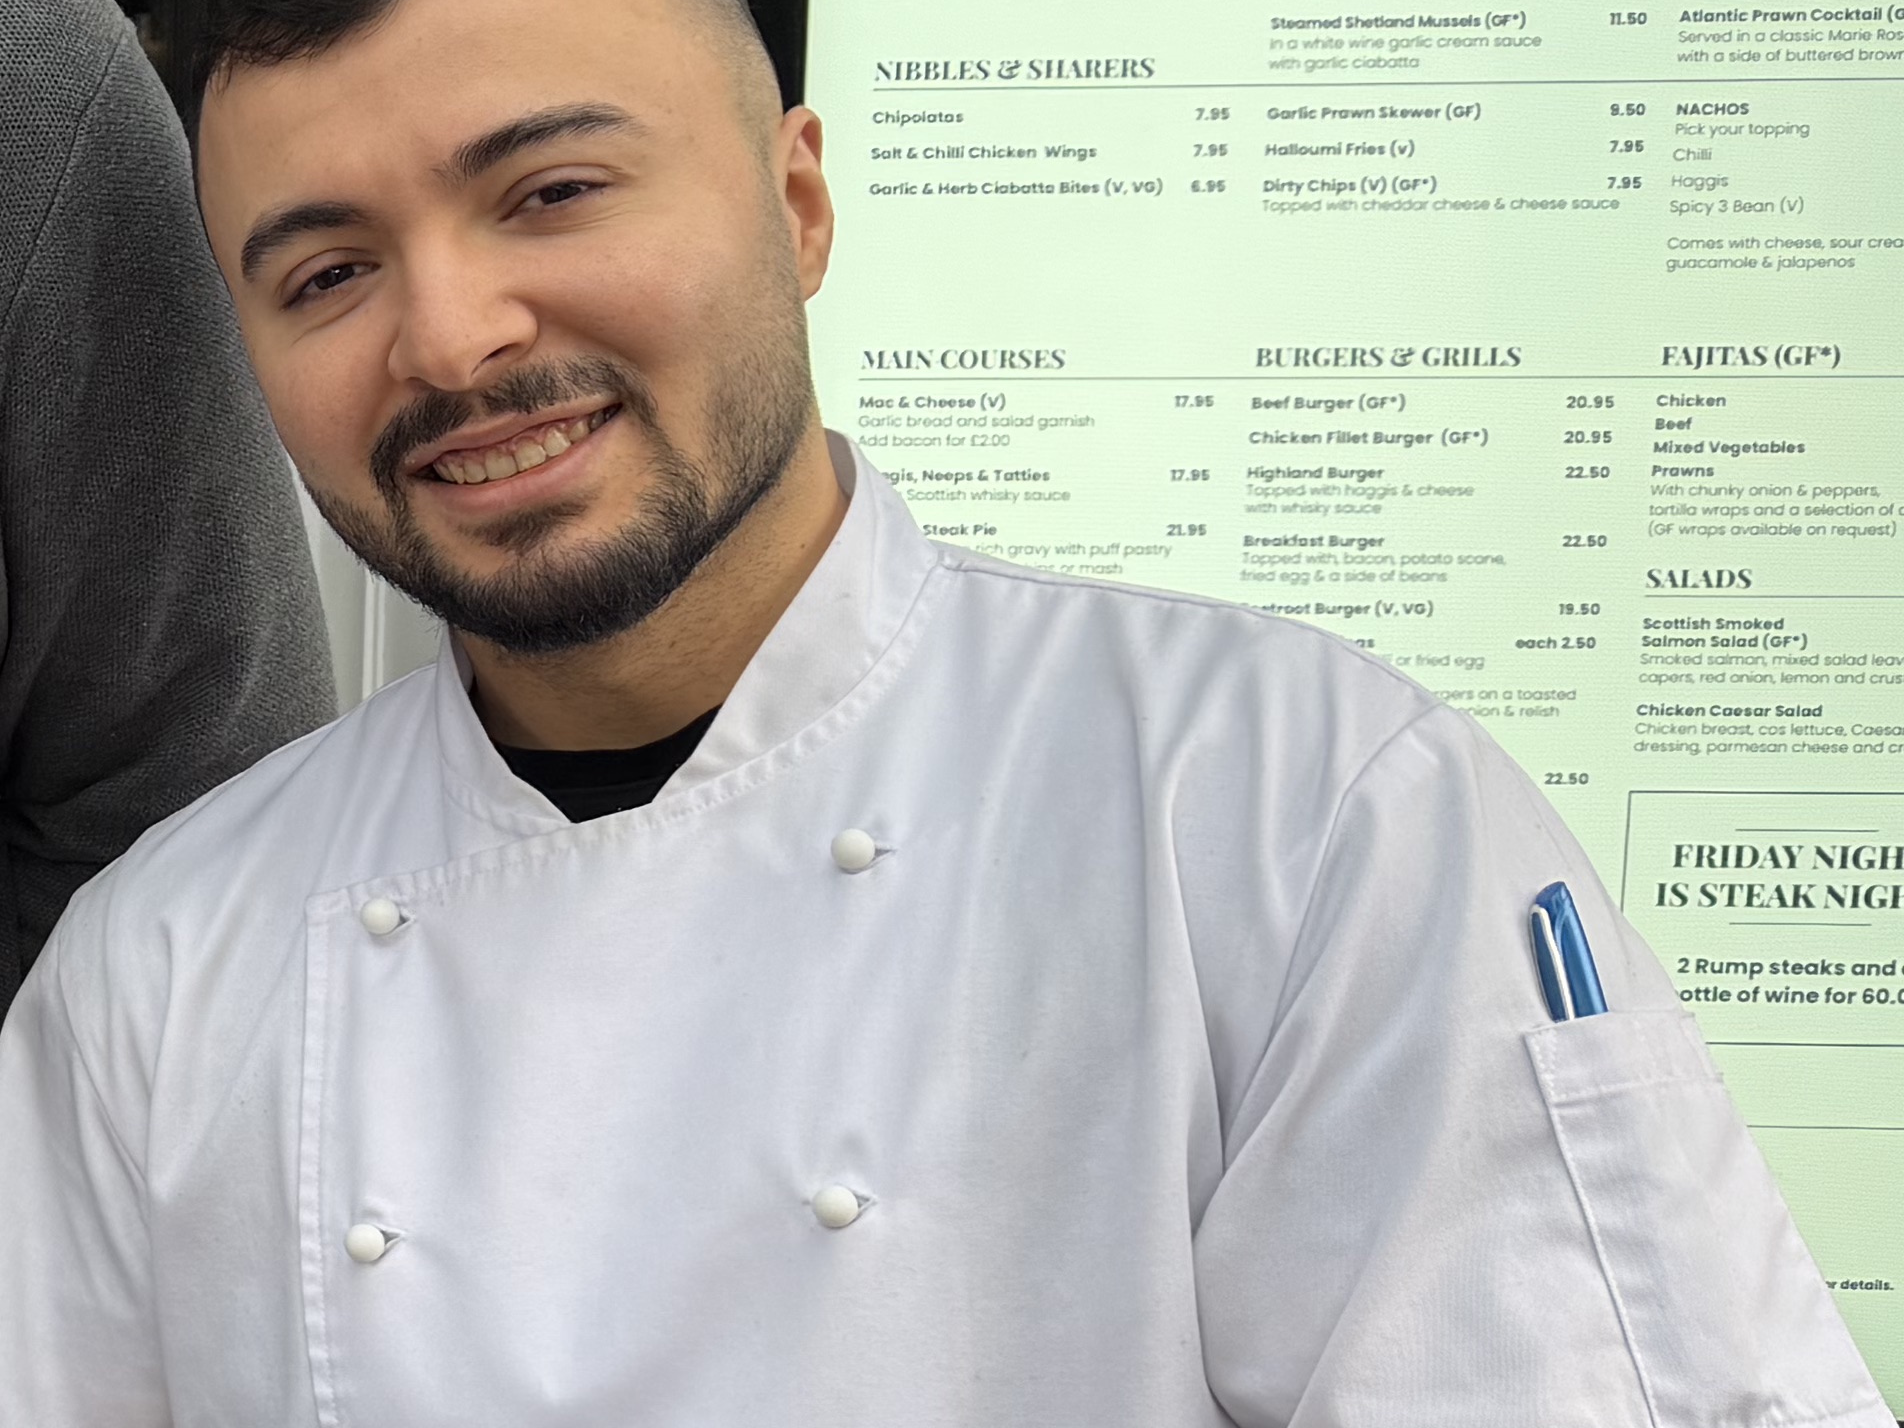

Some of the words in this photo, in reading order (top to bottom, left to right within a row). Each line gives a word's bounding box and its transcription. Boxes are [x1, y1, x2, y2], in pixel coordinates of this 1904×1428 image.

[876, 60, 990, 81] NIBBLES
[998, 60, 1021, 80] &
[1028, 58, 1154, 80] SHARERS
[1676, 103, 1749, 115] NACHOS
[862, 350, 933, 369] MAIN
[941, 350, 1065, 369] COURSES
[1256, 348, 1383, 367] BURGERS
[1390, 347, 1415, 367] &
[1422, 347, 1521, 367] GRILLS
[1662, 346, 1767, 370] FAJITAS
[1656, 394, 1726, 407] Chicken
[1655, 417, 1692, 430] Beef
[1653, 440, 1704, 453] Mixed
[1709, 441, 1805, 457] Vegetables
[1652, 465, 1714, 477] Prawns
[1647, 569, 1751, 589] SALADS
[1636, 703, 1705, 716] Chicken
[1710, 705, 1771, 717] Caesar
[1776, 705, 1822, 717] Salad
[1674, 844, 1803, 869] FRIDAY
[1813, 846, 1904, 870] NIGH
[1656, 883, 1688, 907] IS
[1698, 883, 1815, 908] STEAK
[1824, 885, 1904, 909] NIG
[1678, 958, 1689, 973] 2
[1695, 959, 1763, 980] Rump
[1769, 959, 1845, 976] steaks
[1851, 960, 1896, 976] and
[1679, 986, 1731, 1002] ottle
[1737, 986, 1760, 1002] of
[1765, 986, 1819, 1003] wine
[1825, 987, 1857, 1004] for
